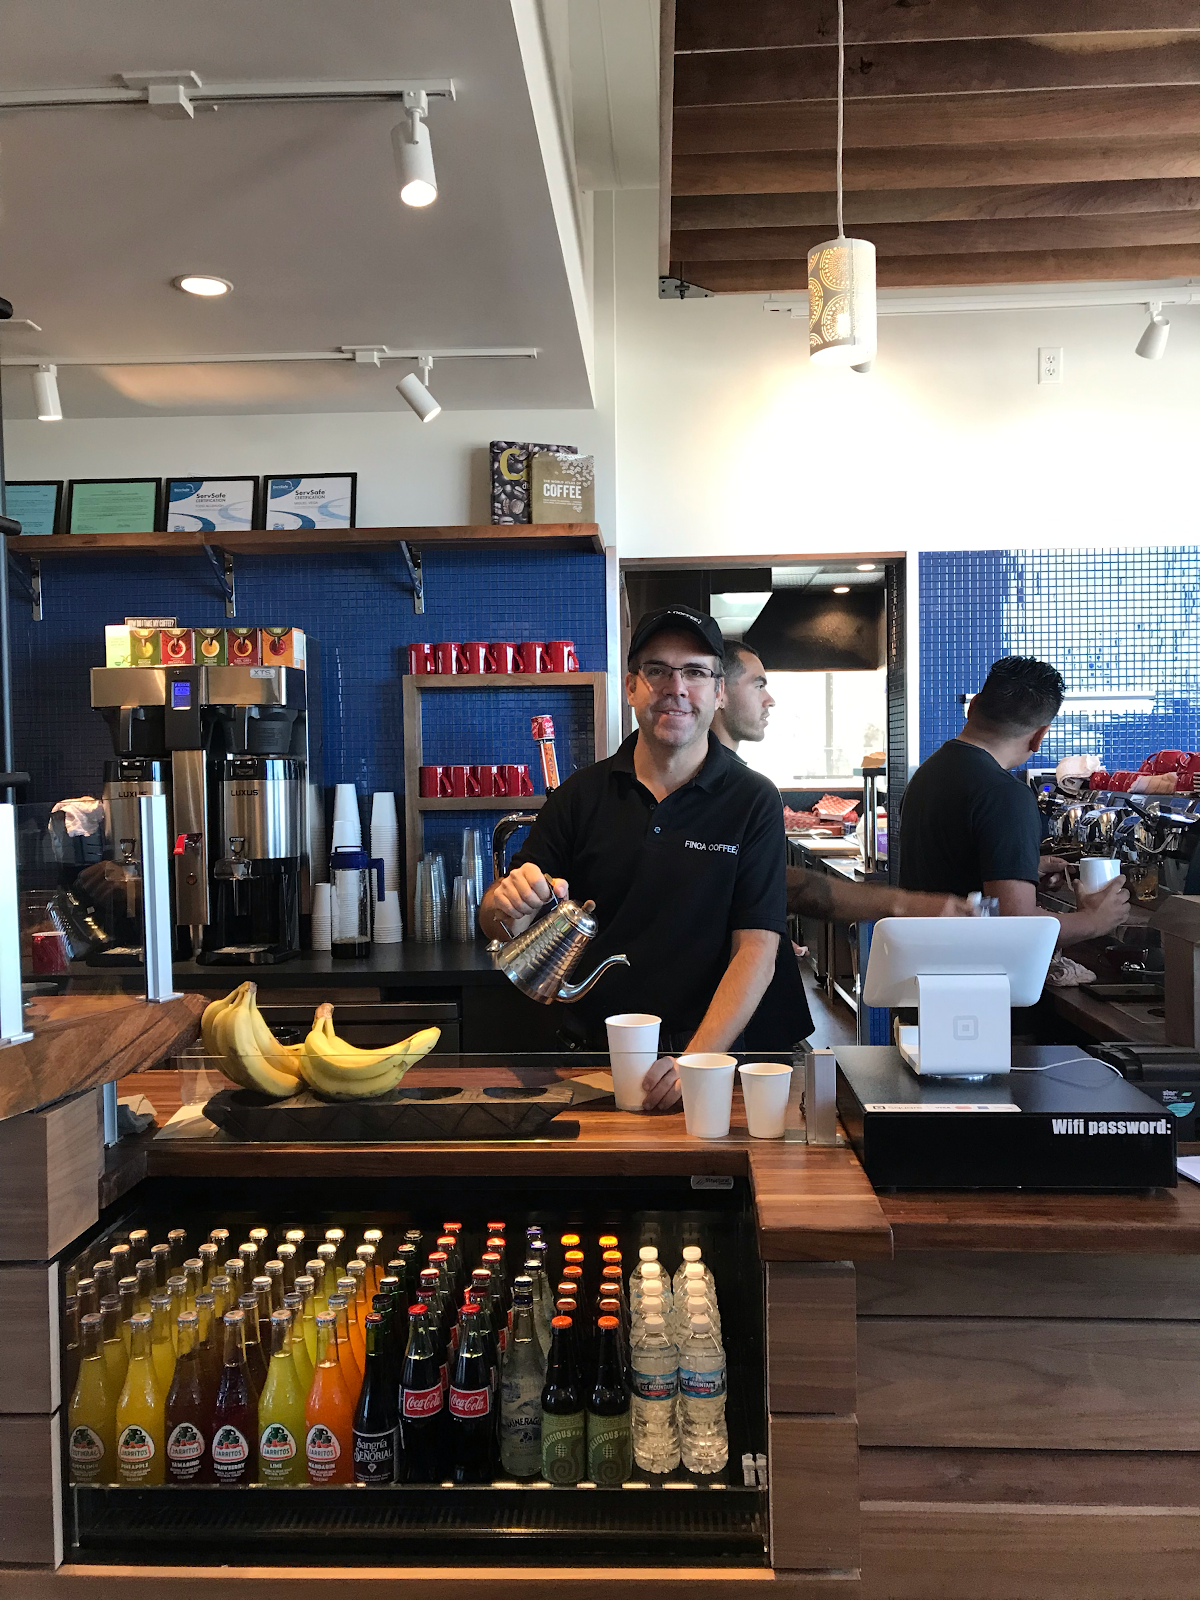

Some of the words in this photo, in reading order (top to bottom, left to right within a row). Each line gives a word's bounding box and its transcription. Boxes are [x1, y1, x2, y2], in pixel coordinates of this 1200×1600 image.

[543, 483, 582, 498] COFFEE
[684, 840, 706, 850] FINCA
[708, 844, 737, 854] COFFEE
[1052, 1119, 1084, 1134] Wifi
[1088, 1119, 1172, 1136] password:
[406, 1391, 440, 1410] Coca-Cola
[451, 1394, 484, 1411] Coca-Cola
[309, 1448, 334, 1456] JARRITOS
[356, 1438, 387, 1452] Sangría
[354, 1448, 393, 1462] SEÑORIAL
